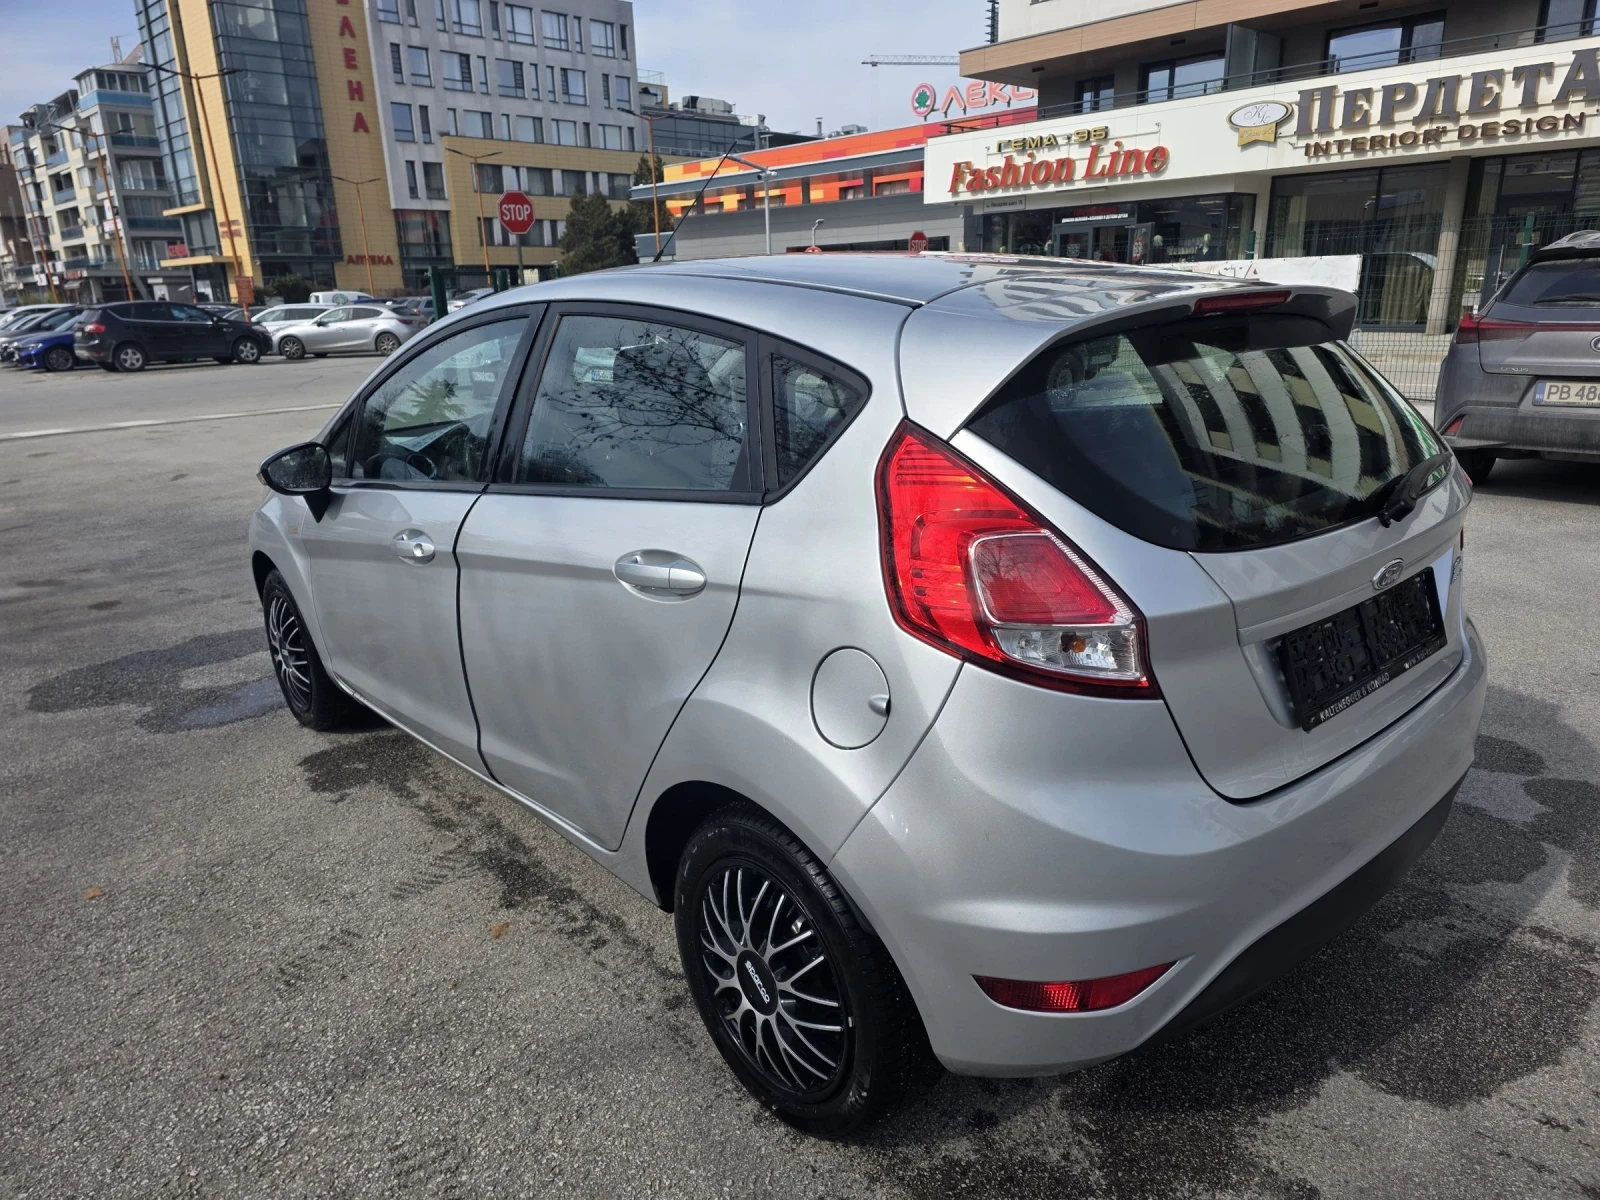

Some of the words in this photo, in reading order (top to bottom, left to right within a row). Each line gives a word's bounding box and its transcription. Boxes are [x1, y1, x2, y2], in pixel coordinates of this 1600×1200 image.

[336, 0, 371, 134] ЛЕНА
[1304, 128, 1443, 157] INTERIOR
[1457, 111, 1587, 140] DESIGN
[948, 152, 1076, 193] Fashion
[1082, 140, 1169, 179] Line
[502, 204, 531, 221] STOP
[911, 239, 927, 251] STOP
[1547, 384, 1571, 400] PB
[1575, 385, 1600, 401] 48
[1367, 672, 1390, 693] KONRAD
